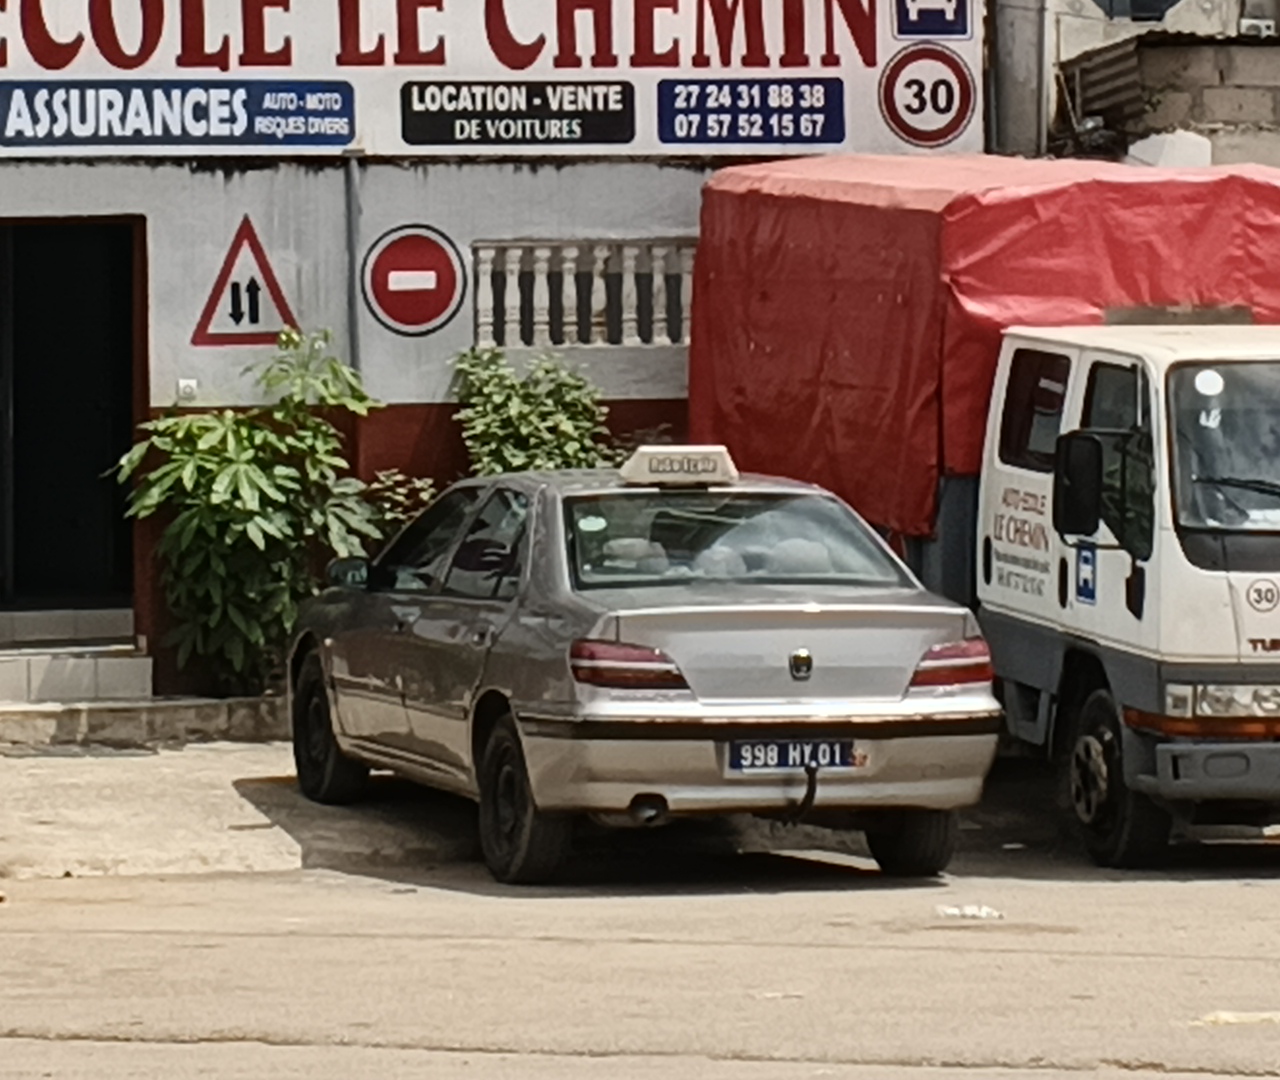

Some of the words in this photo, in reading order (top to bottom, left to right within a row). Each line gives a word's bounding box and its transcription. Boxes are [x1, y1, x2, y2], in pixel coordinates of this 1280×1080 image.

[411, 85, 527, 112] LOCATION
[545, 85, 624, 111] VENTE
[674, 85, 700, 109] 27
[705, 85, 731, 109] 24
[736, 85, 761, 109] 31
[767, 85, 793, 109] 88
[799, 85, 825, 109] 38
[903, 78, 955, 115] 30
[5, 86, 248, 138] ASSURANCES
[254, 116, 306, 139] RISQUES
[308, 117, 350, 135] DIVERS
[455, 119, 481, 140] DE
[485, 119, 582, 140] VOITURES
[674, 114, 701, 138] 07
[706, 114, 732, 138] 57
[737, 114, 763, 138] 52
[769, 114, 794, 137] 15
[799, 113, 825, 138] 67
[1252, 587, 1274, 605] 30
[740, 743, 779, 766] 998
[818, 742, 841, 766] 01
